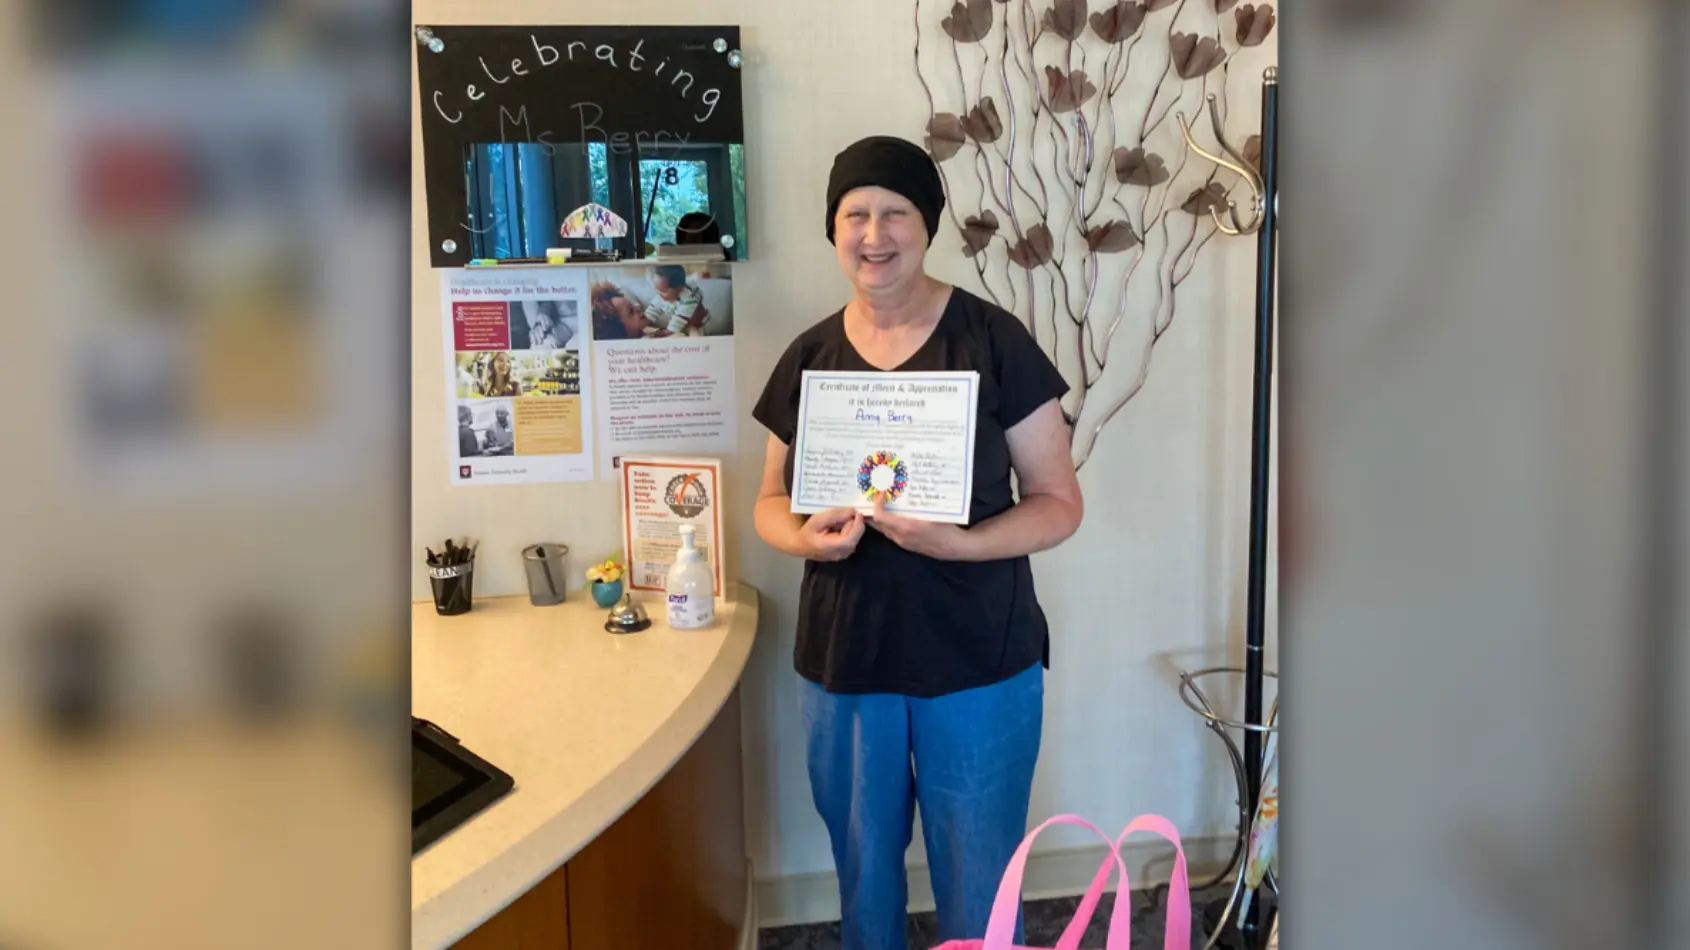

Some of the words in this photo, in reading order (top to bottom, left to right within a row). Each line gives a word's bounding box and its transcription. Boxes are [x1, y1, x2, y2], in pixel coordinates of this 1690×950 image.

[434, 34, 721, 122] Celebrating
[499, 104, 556, 156] Ms
[570, 101, 691, 156] Berry
[451, 287, 470, 296] Help
[484, 287, 512, 296] change
[523, 286, 534, 294] for
[537, 286, 549, 294] the
[551, 285, 577, 294] better.
[607, 348, 645, 357] Questions
[648, 346, 669, 355] about
[671, 346, 683, 354] the
[702, 345, 710, 353] of
[608, 358, 625, 366] your
[627, 355, 670, 365] healthcare?
[608, 366, 621, 374] We
[624, 366, 637, 374] can
[819, 382, 859, 391] Certificate
[861, 382, 870, 391] of
[872, 383, 895, 392] Merit
[897, 383, 905, 392] &
[908, 383, 958, 394] Appreciation
[866, 398, 892, 408] hereby
[855, 408, 881, 425] Amy
[887, 409, 913, 425] Berry
